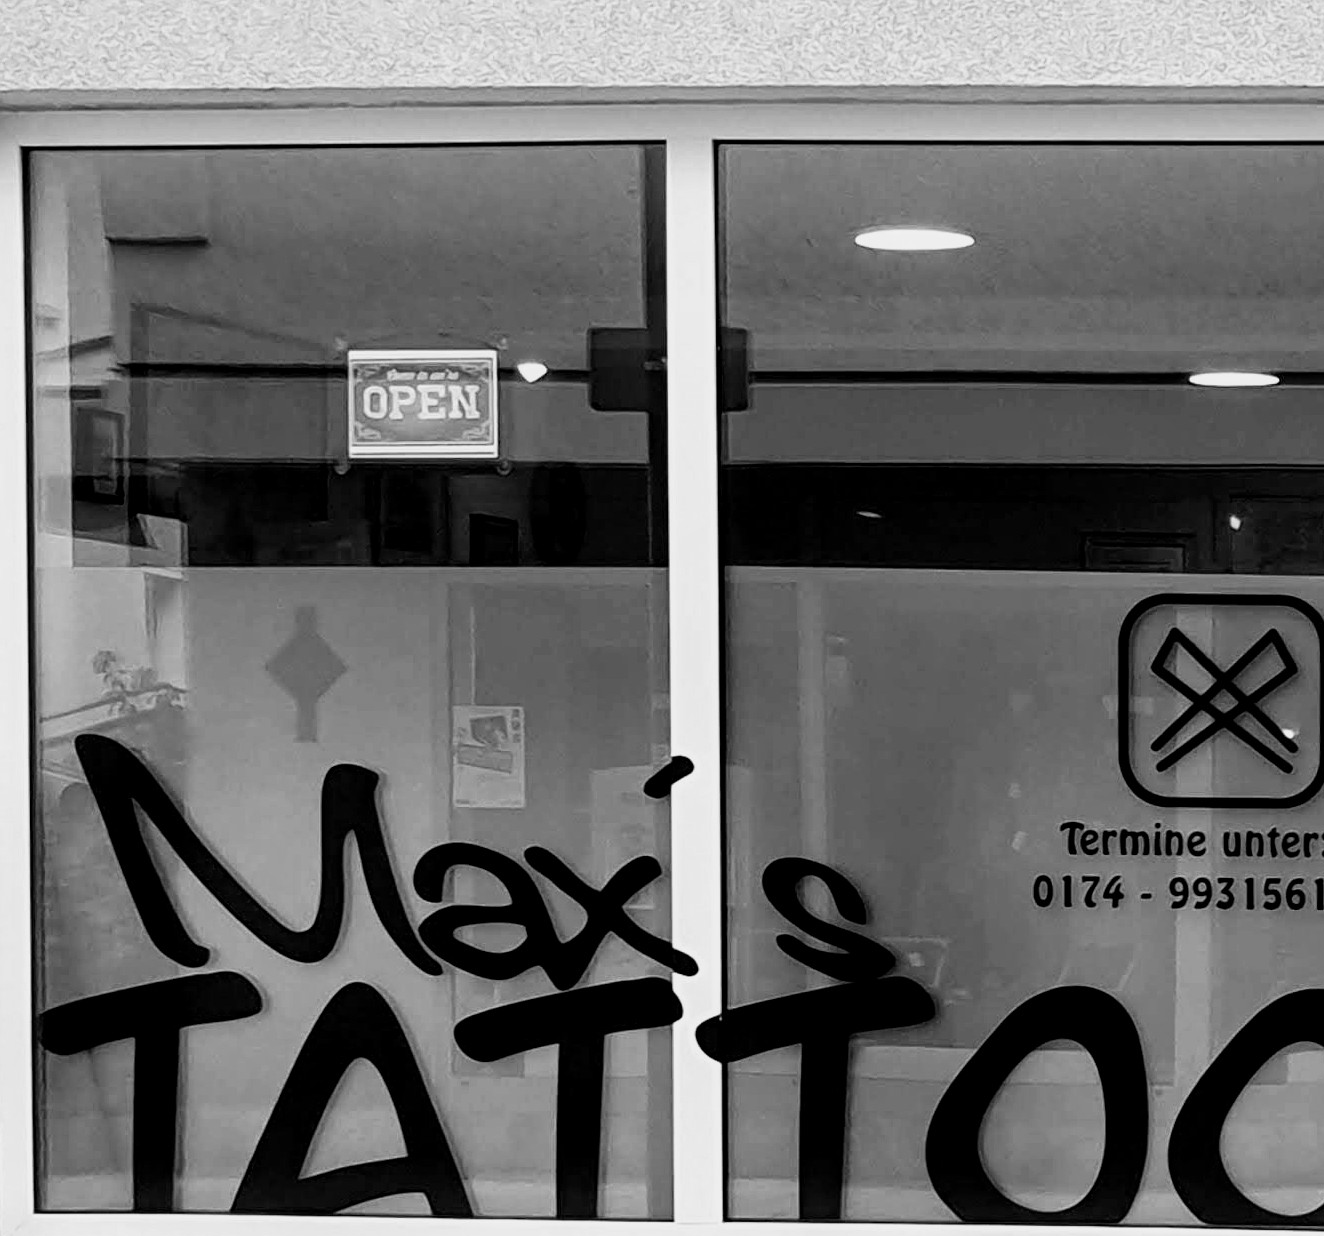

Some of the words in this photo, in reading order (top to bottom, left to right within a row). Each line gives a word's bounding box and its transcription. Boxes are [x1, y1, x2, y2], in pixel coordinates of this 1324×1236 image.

[363, 385, 481, 420] OPEN
[1060, 821, 1207, 856] Termine
[1032, 874, 1125, 909] 0174
